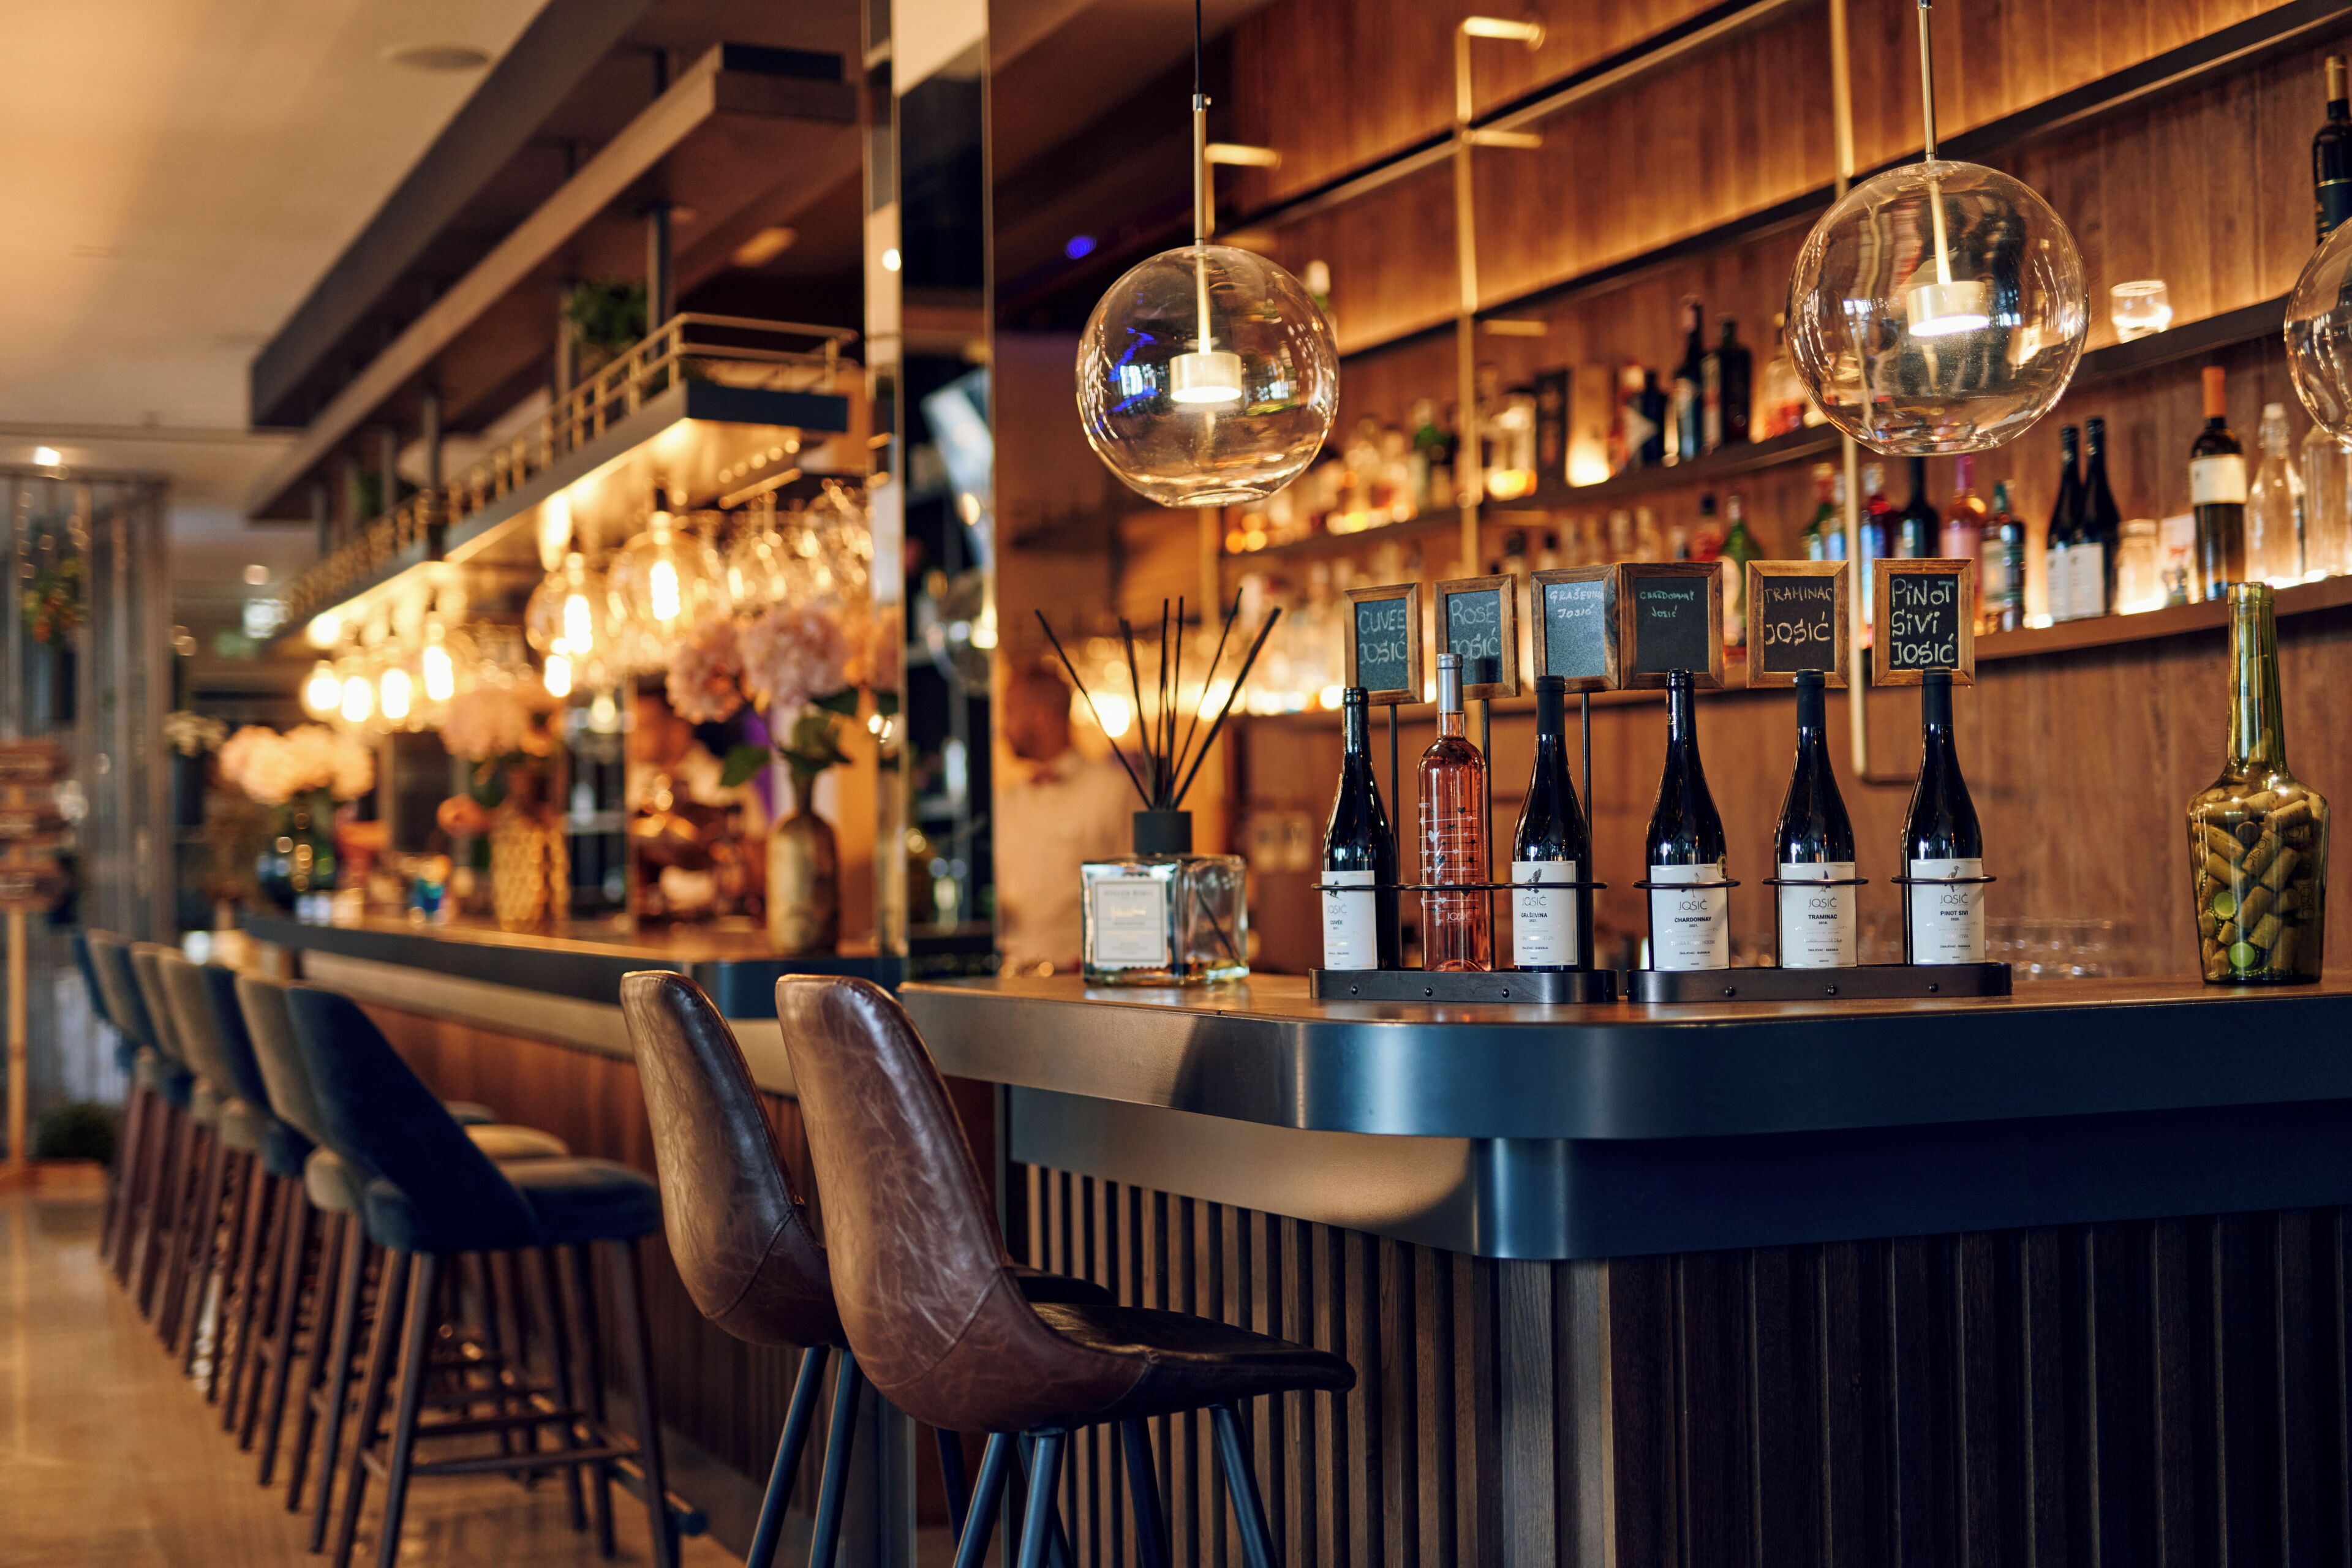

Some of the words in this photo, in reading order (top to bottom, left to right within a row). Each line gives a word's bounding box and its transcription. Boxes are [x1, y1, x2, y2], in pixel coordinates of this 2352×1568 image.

[1765, 586, 1833, 603] TRAMINAC
[1359, 602, 1406, 634] CUVÉE
[1765, 611, 1830, 647] JOSIĆ
[1891, 633, 1954, 665] JOSIĆ
[1522, 895, 1547, 907] JOSIĆ
[1678, 899, 1708, 911] JOSIĆ
[1808, 897, 1837, 908] JOSIĆ
[1940, 893, 1969, 904] JOSIĆ
